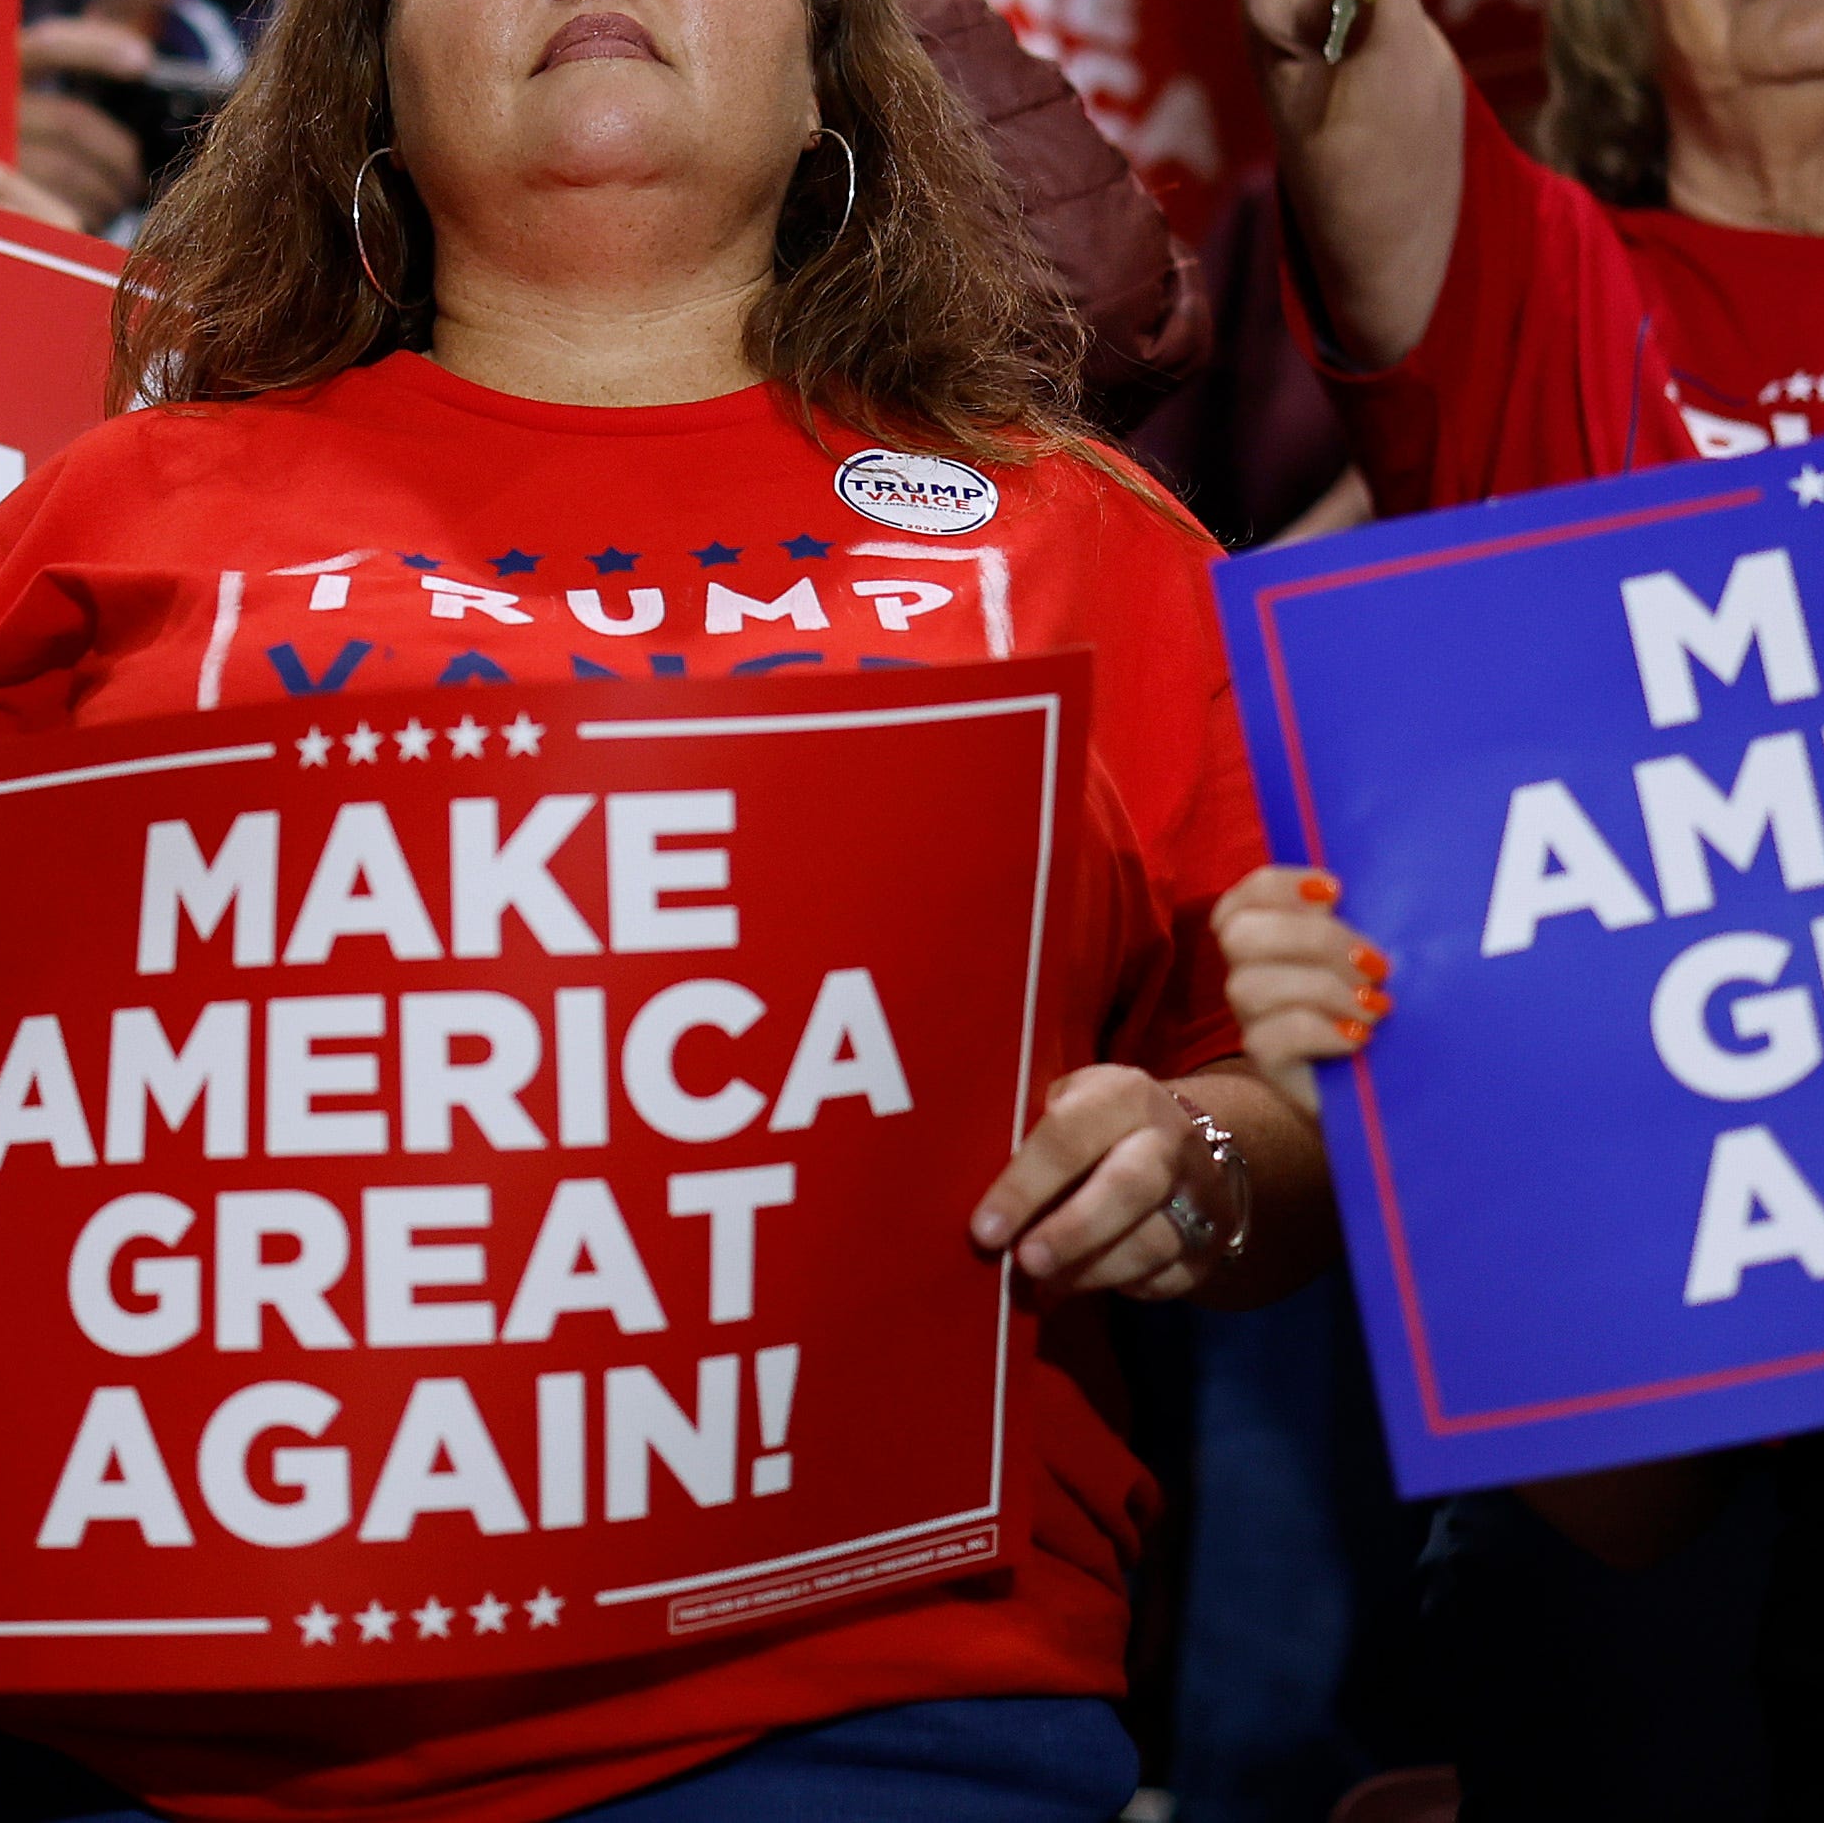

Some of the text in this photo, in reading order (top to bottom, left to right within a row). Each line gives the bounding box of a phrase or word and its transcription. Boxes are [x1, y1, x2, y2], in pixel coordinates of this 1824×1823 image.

[847, 479, 984, 501] TRUMP
[865, 490, 971, 511] VANCE
[906, 523, 939, 533] 2024
[267, 548, 955, 636] TRUMP
[138, 790, 738, 974] MAKE
[69, 1164, 794, 1356] GREAT
[37, 1344, 798, 1548] AGAIN!
